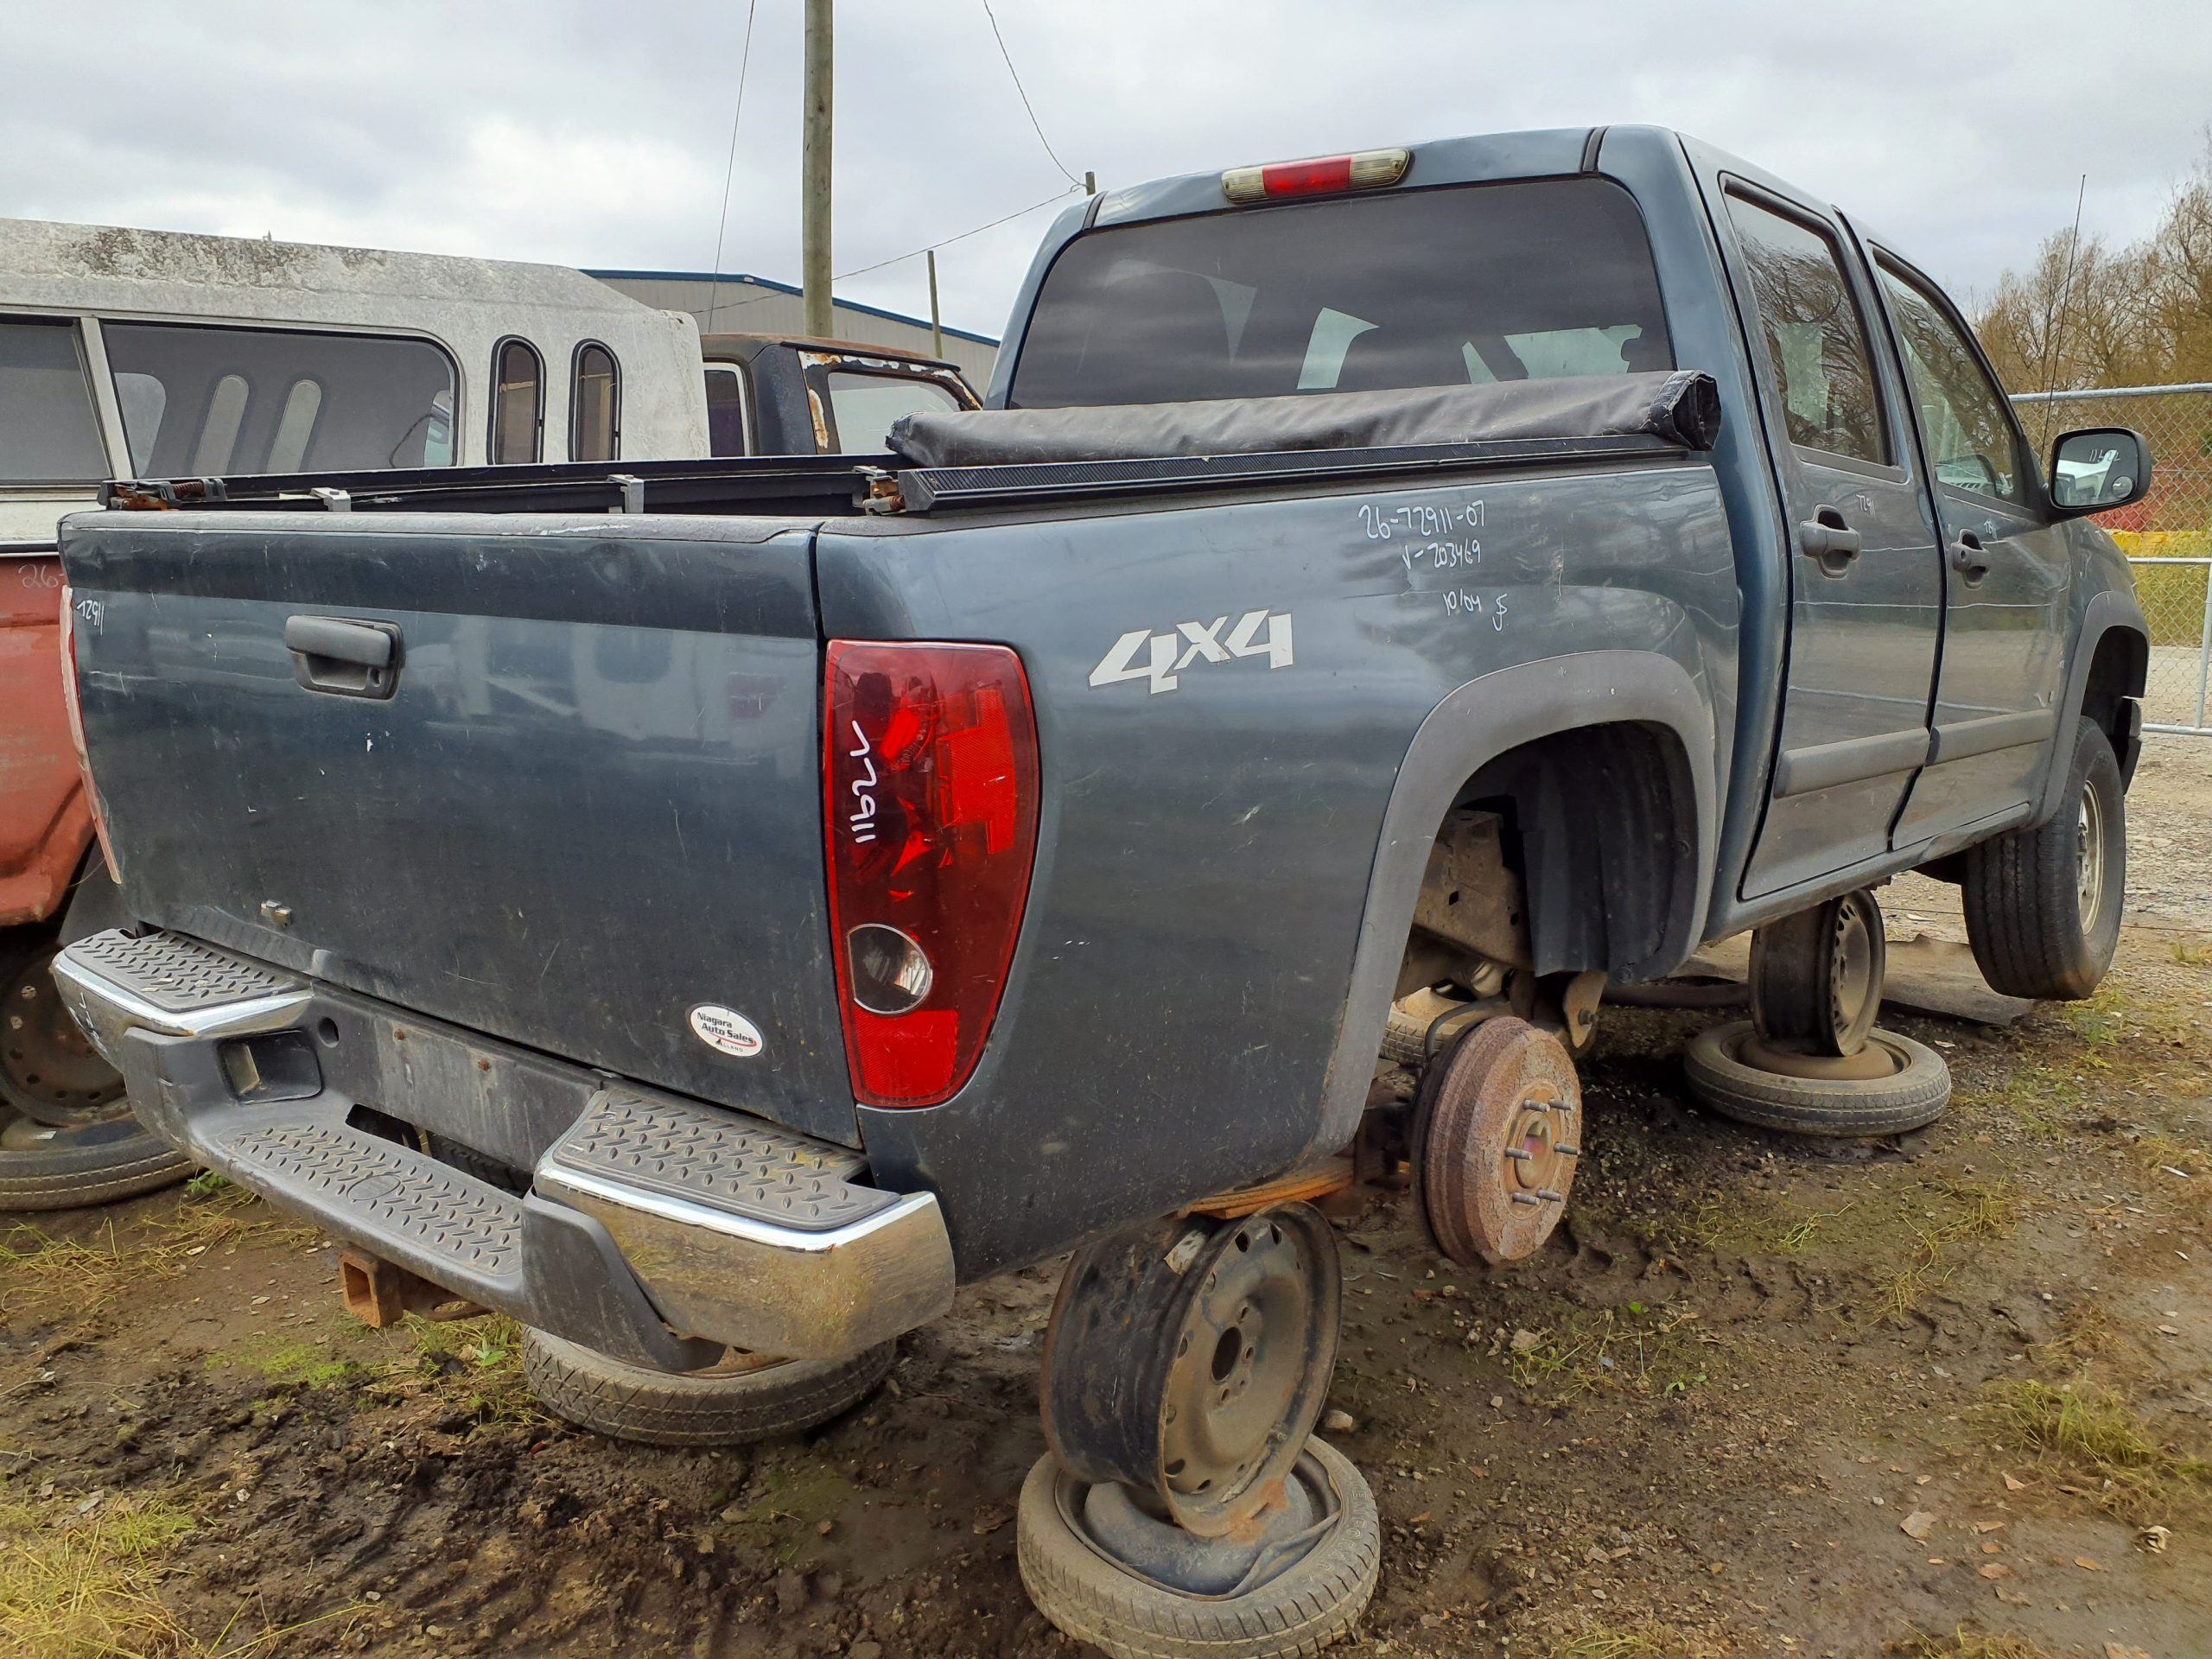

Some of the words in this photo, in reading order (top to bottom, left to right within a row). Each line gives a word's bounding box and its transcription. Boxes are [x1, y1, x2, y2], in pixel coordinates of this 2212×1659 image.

[1357, 499, 1485, 539] 26-72911-07
[849, 720, 877, 843] 72911
[696, 1012, 733, 1028] Niagara
[701, 1022, 726, 1036] Auto
[727, 1029, 753, 1044] Sales
